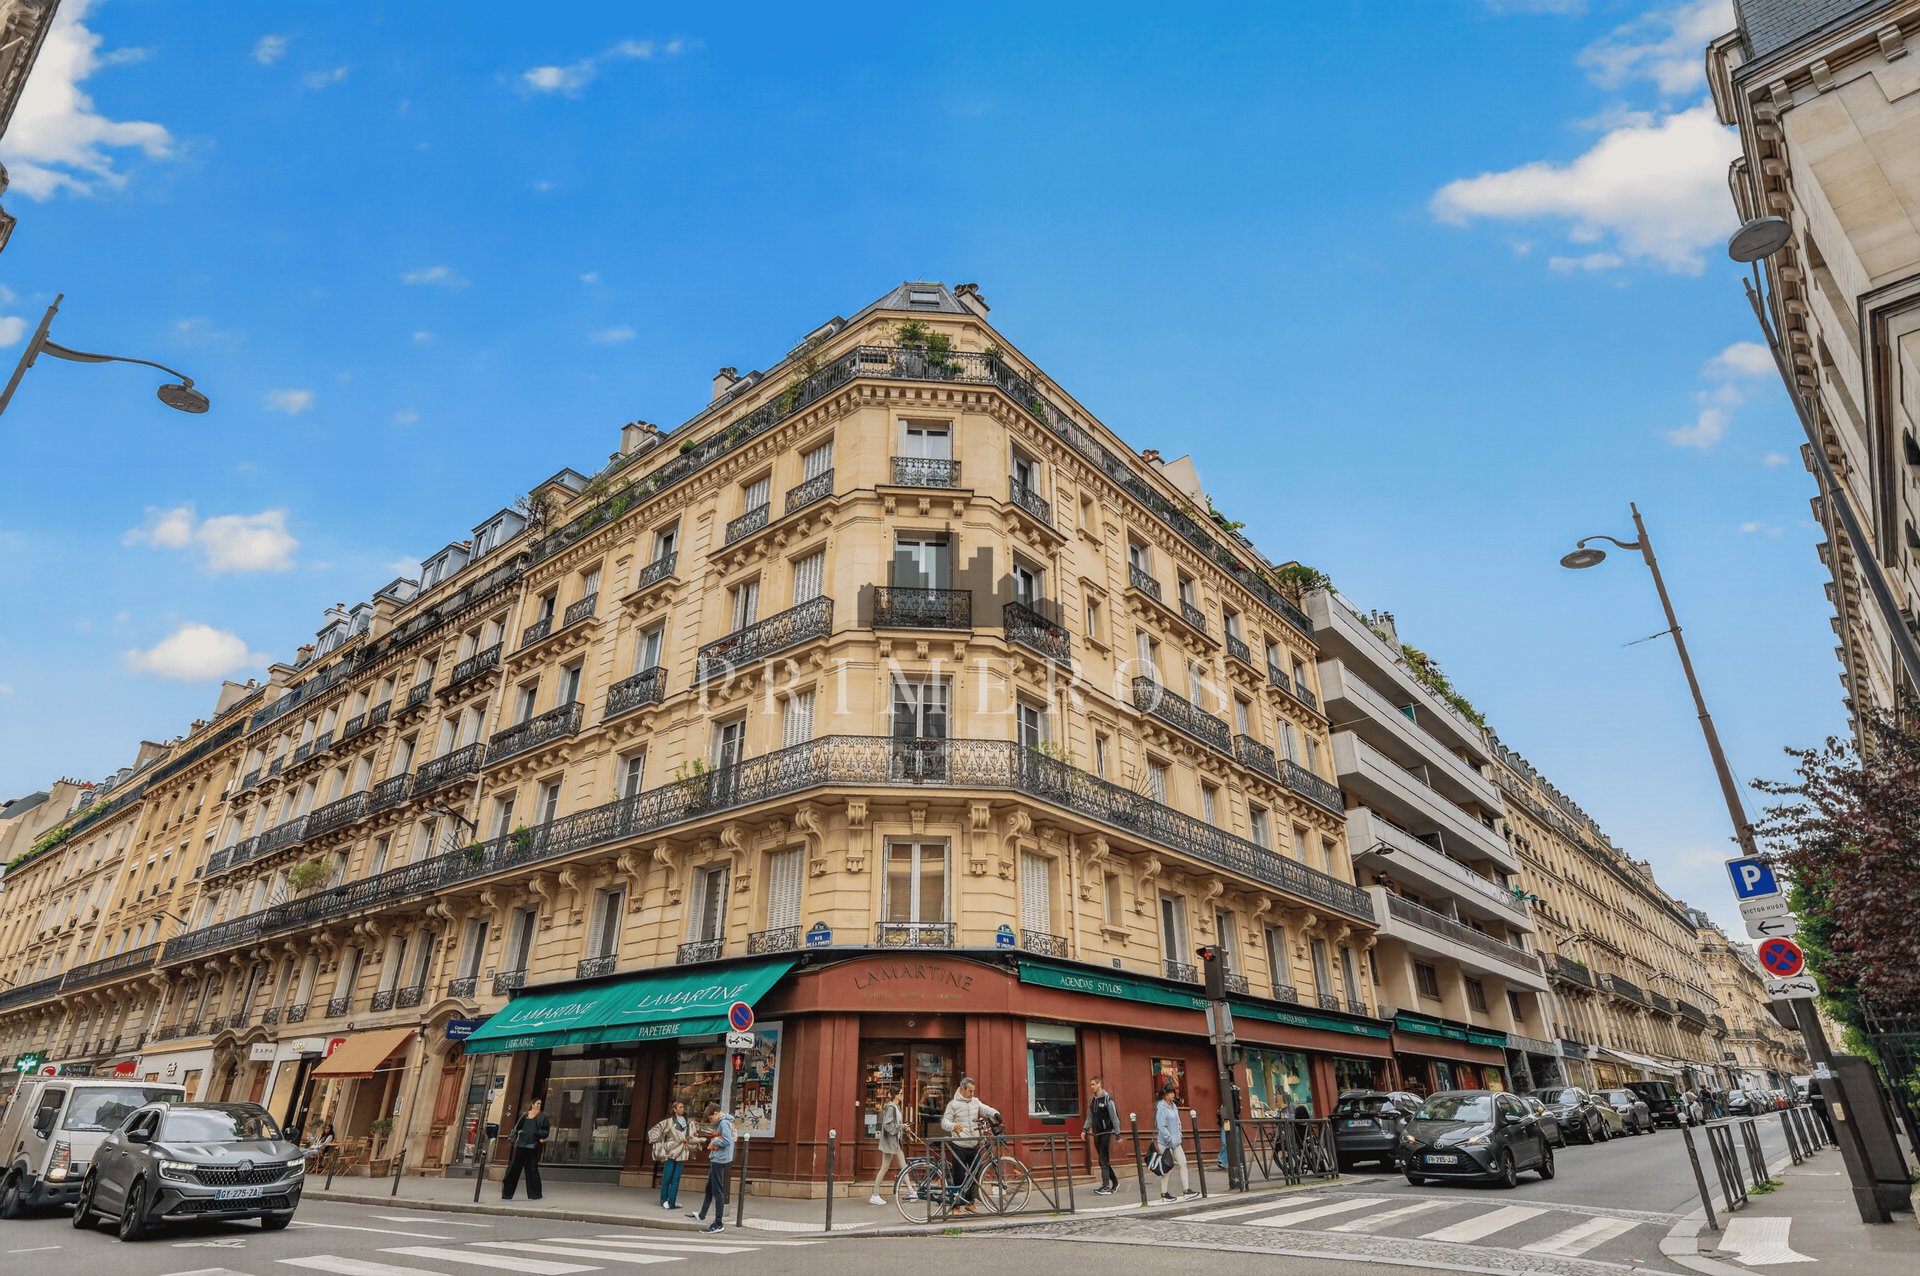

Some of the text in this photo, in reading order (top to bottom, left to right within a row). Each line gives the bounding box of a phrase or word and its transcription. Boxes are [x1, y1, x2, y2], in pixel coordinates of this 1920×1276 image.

[1740, 865, 1761, 891] P
[1742, 903, 1785, 915] VICTOR HUGO
[855, 963, 974, 991] LAMARTINE
[1060, 976, 1123, 994] AGENDAS STYLOS
[638, 983, 748, 1008] LAMARTINE
[510, 1001, 597, 1023] LAMARTINE
[638, 1023, 680, 1037] PAPETERIE
[504, 1037, 536, 1049] LIBRAIRIE
[221, 1188, 257, 1199] GY-275-ZA
